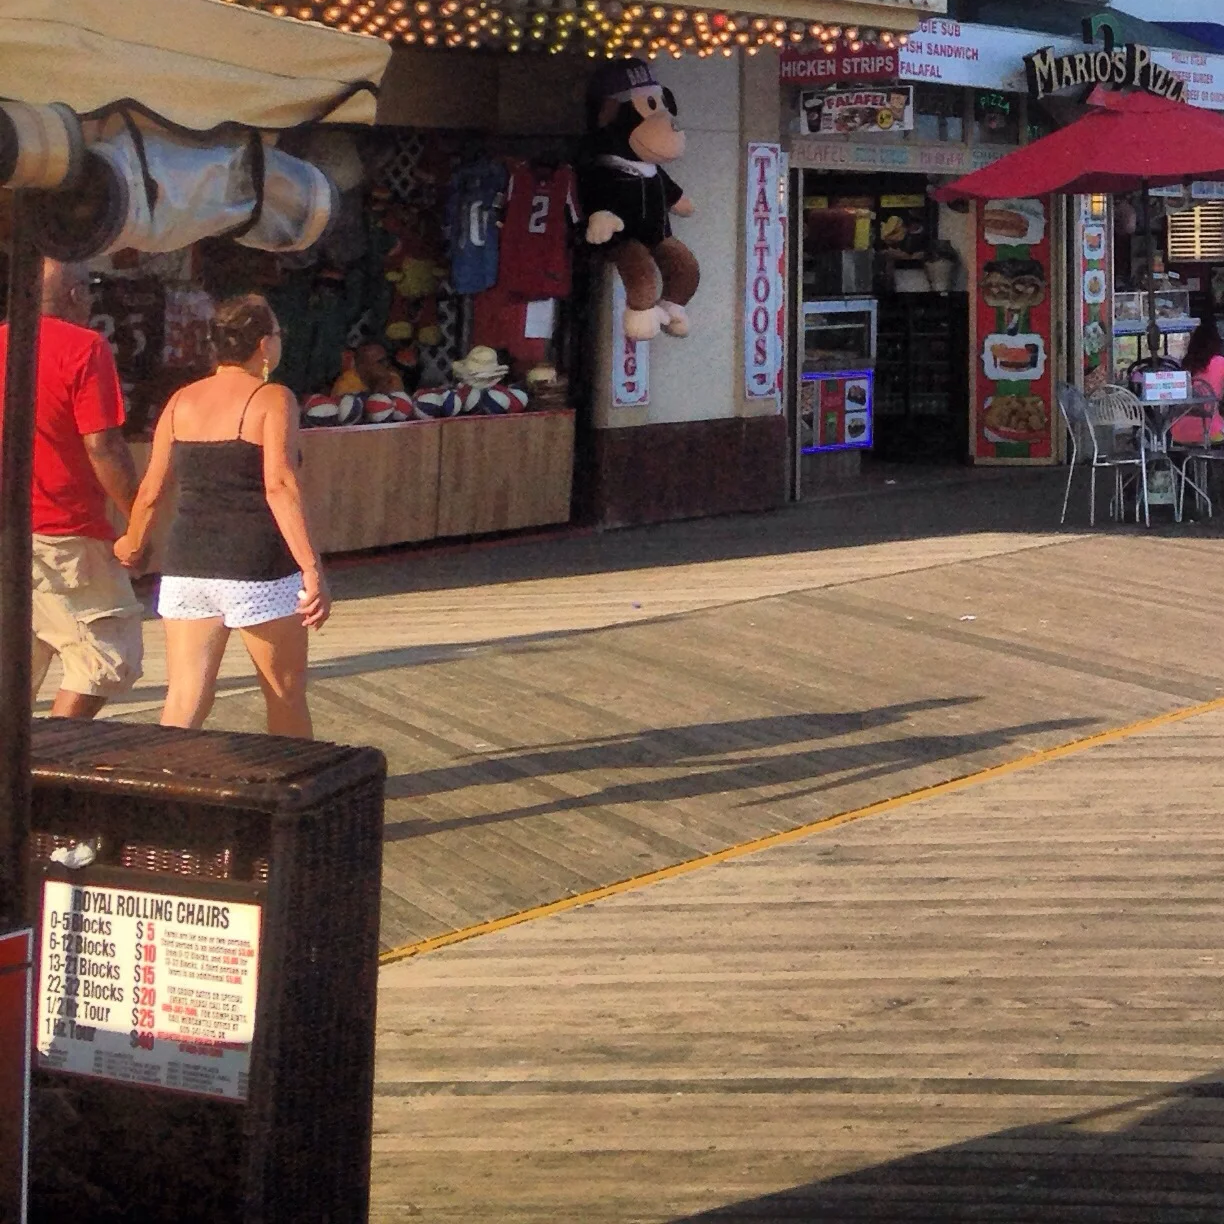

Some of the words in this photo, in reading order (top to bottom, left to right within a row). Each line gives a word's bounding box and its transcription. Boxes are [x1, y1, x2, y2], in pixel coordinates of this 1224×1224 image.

[940, 21, 961, 38] SUB
[842, 56, 894, 74] STRIPS
[926, 43, 979, 61] SANDWICH
[1032, 45, 1127, 100] MARIO'S
[825, 94, 888, 109] FALAFEL
[528, 195, 550, 234] 2
[752, 155, 771, 366] TATTOOS
[73, 889, 113, 916] ROYAL
[116, 895, 173, 923] ROLLING
[176, 901, 230, 930] CHAIRS
[50, 910, 71, 931] 0-5
[71, 913, 112, 937] Blocks
[136, 921, 144, 940] $
[146, 923, 155, 941] 5
[49, 932, 75, 954] 6-12
[75, 935, 116, 958] Blocks
[134, 943, 156, 964] $10
[79, 957, 121, 981] Blocks
[133, 965, 155, 985] $15
[82, 979, 124, 1002] Blocks
[132, 986, 156, 1007] $20
[84, 1001, 111, 1023] Tour
[131, 1007, 155, 1029] $25
